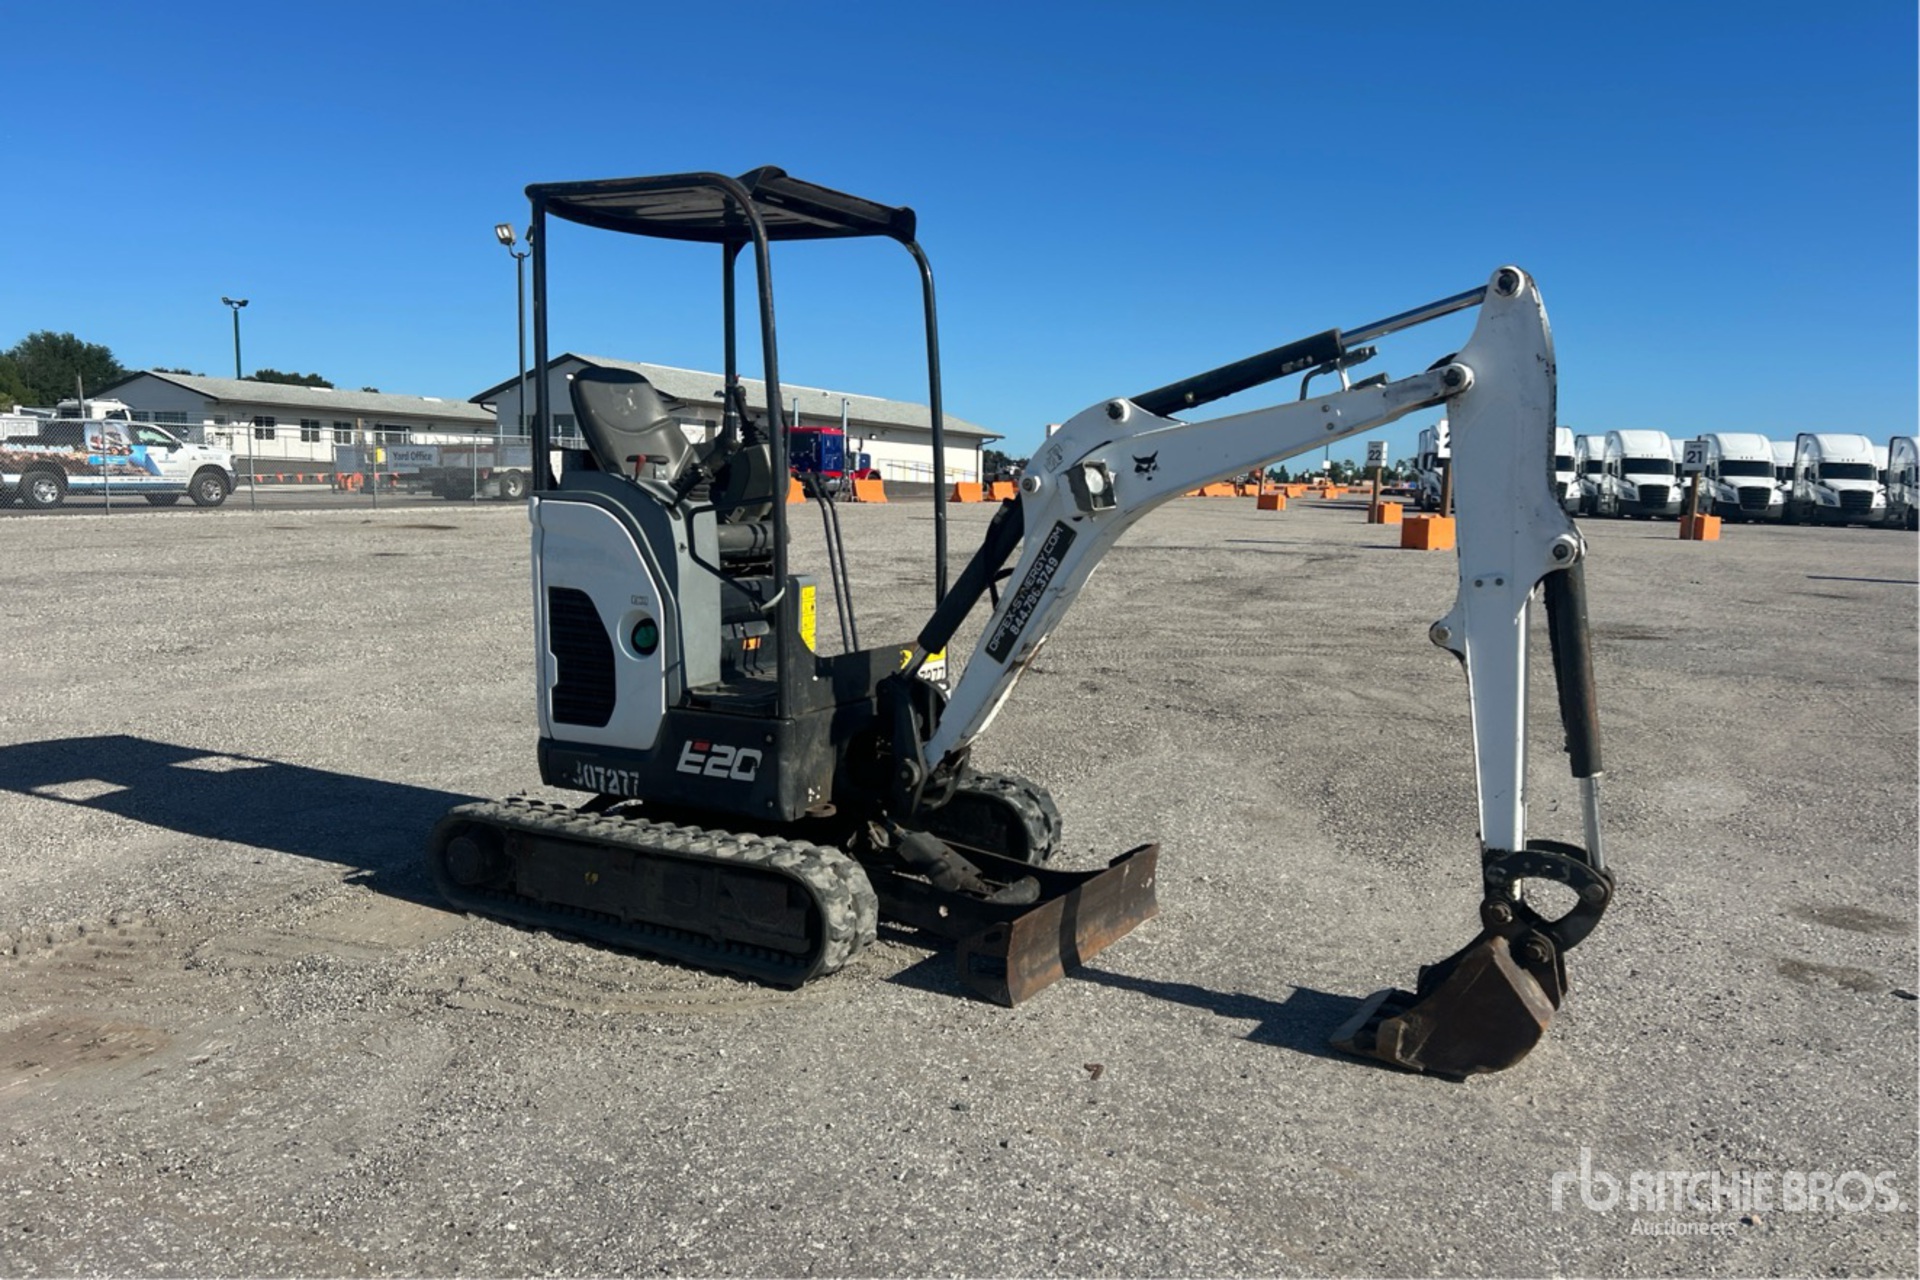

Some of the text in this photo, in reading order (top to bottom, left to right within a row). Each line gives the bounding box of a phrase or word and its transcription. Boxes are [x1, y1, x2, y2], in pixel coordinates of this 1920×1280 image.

[392, 450, 433, 461] Yard Office
[1368, 449, 1382, 461] 22
[1686, 450, 1703, 464] 21
[988, 526, 1063, 652] OPIFEX-SYNERGY.COM
[1009, 556, 1059, 635] 844.796.3749
[676, 740, 763, 782] E20
